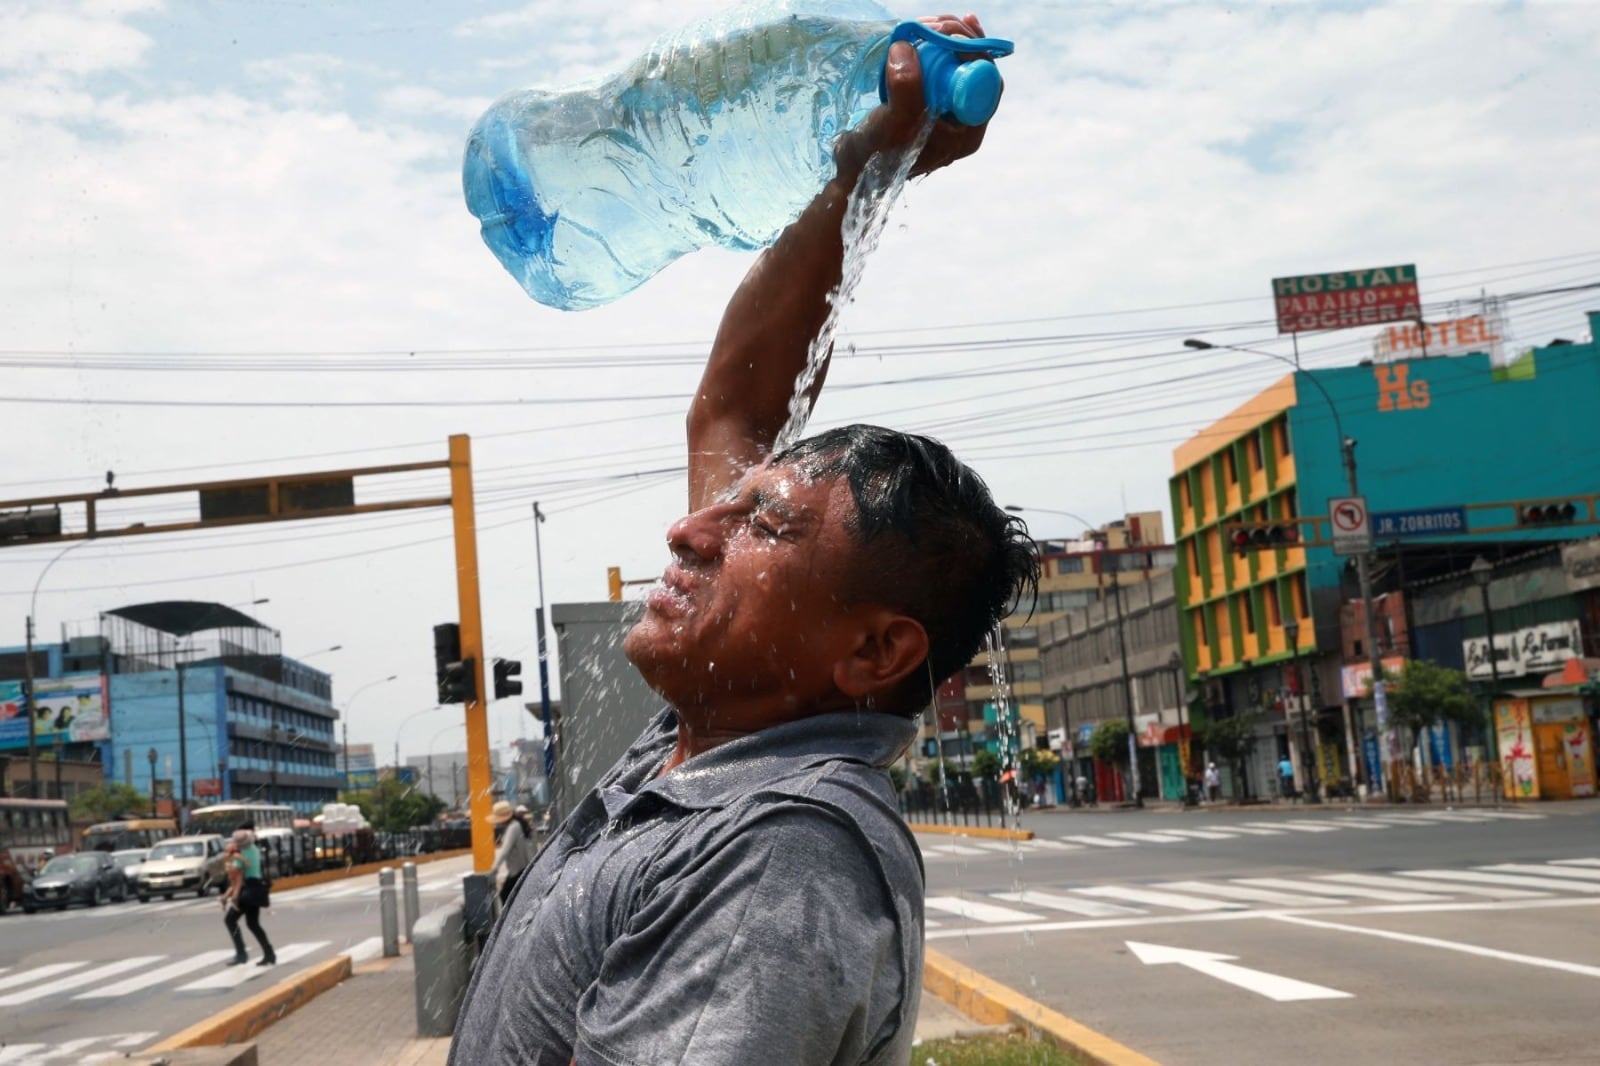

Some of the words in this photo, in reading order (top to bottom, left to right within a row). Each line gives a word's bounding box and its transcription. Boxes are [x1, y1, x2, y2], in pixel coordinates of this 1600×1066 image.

[1278, 266, 1414, 295] HOSTAL
[1279, 290, 1376, 312] PARAISO
[1280, 303, 1419, 331] COCHERA
[1388, 316, 1499, 350] HOTEL
[1378, 518, 1398, 534] JR.
[1401, 512, 1460, 532] ZORRITOS
